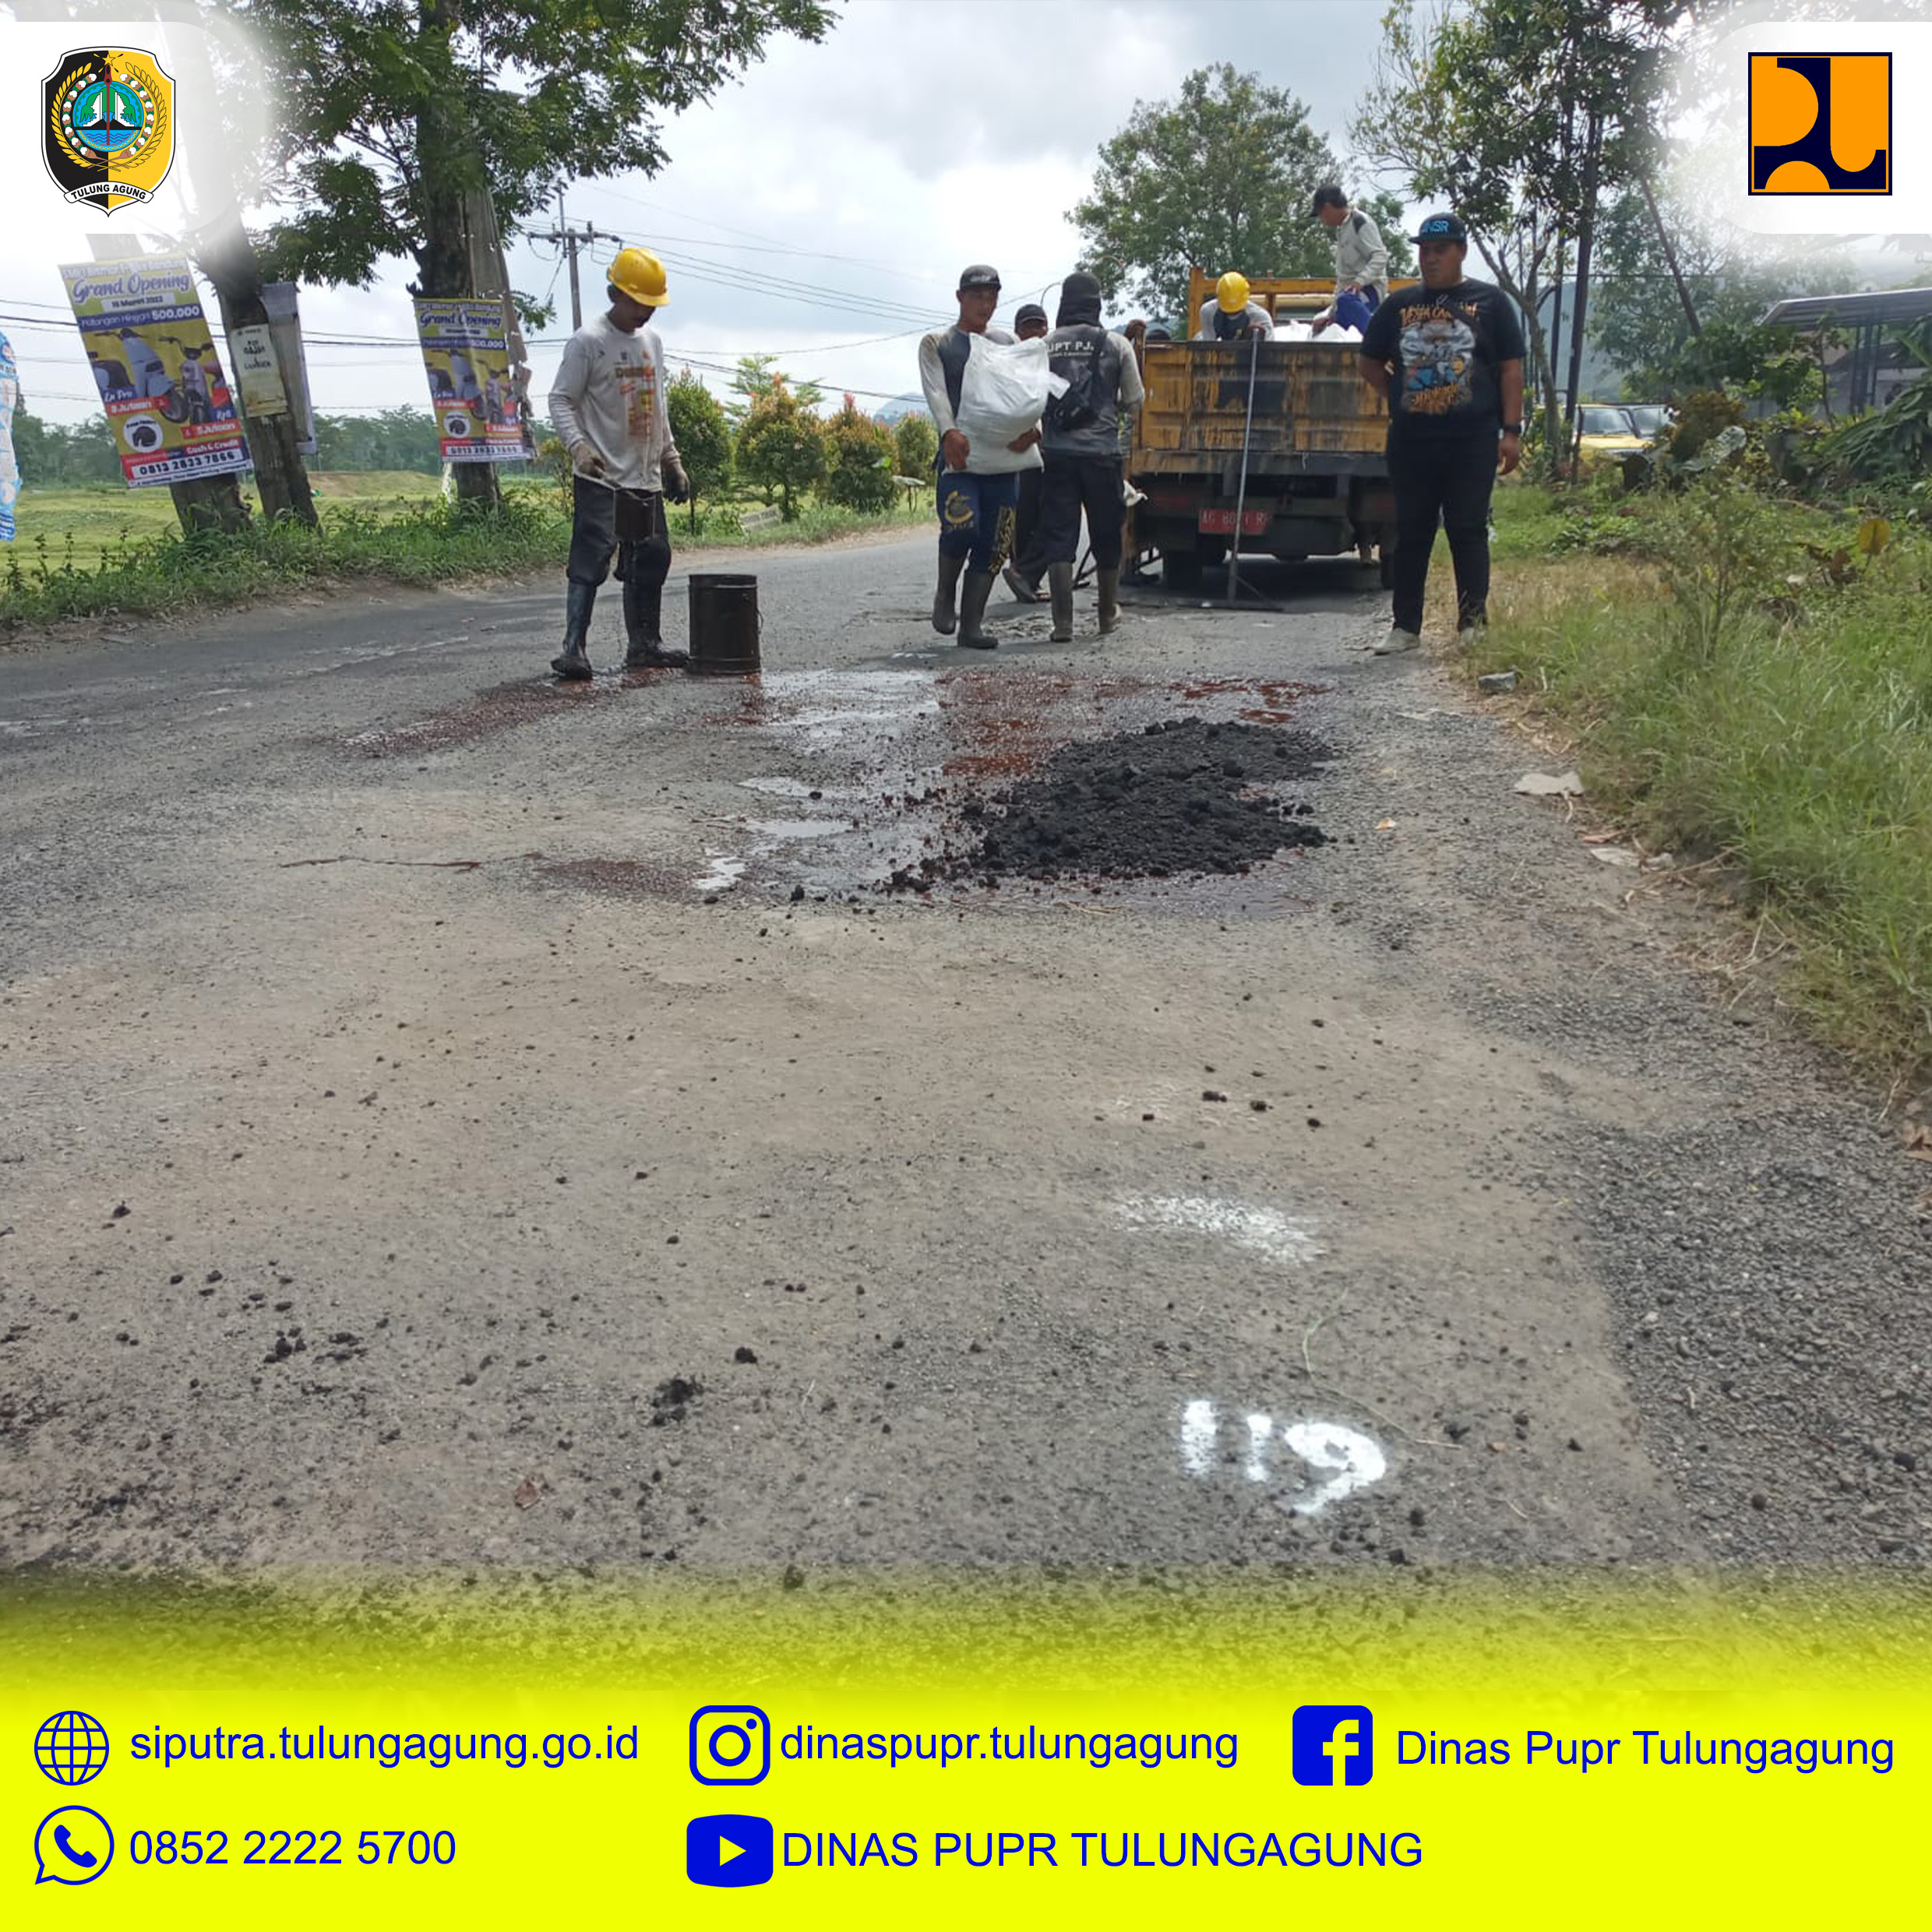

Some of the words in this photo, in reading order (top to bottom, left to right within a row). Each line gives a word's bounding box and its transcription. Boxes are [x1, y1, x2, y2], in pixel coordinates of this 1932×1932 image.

[72, 277, 124, 304] Grand
[128, 273, 191, 294] Opening
[421, 312, 456, 327] Grand
